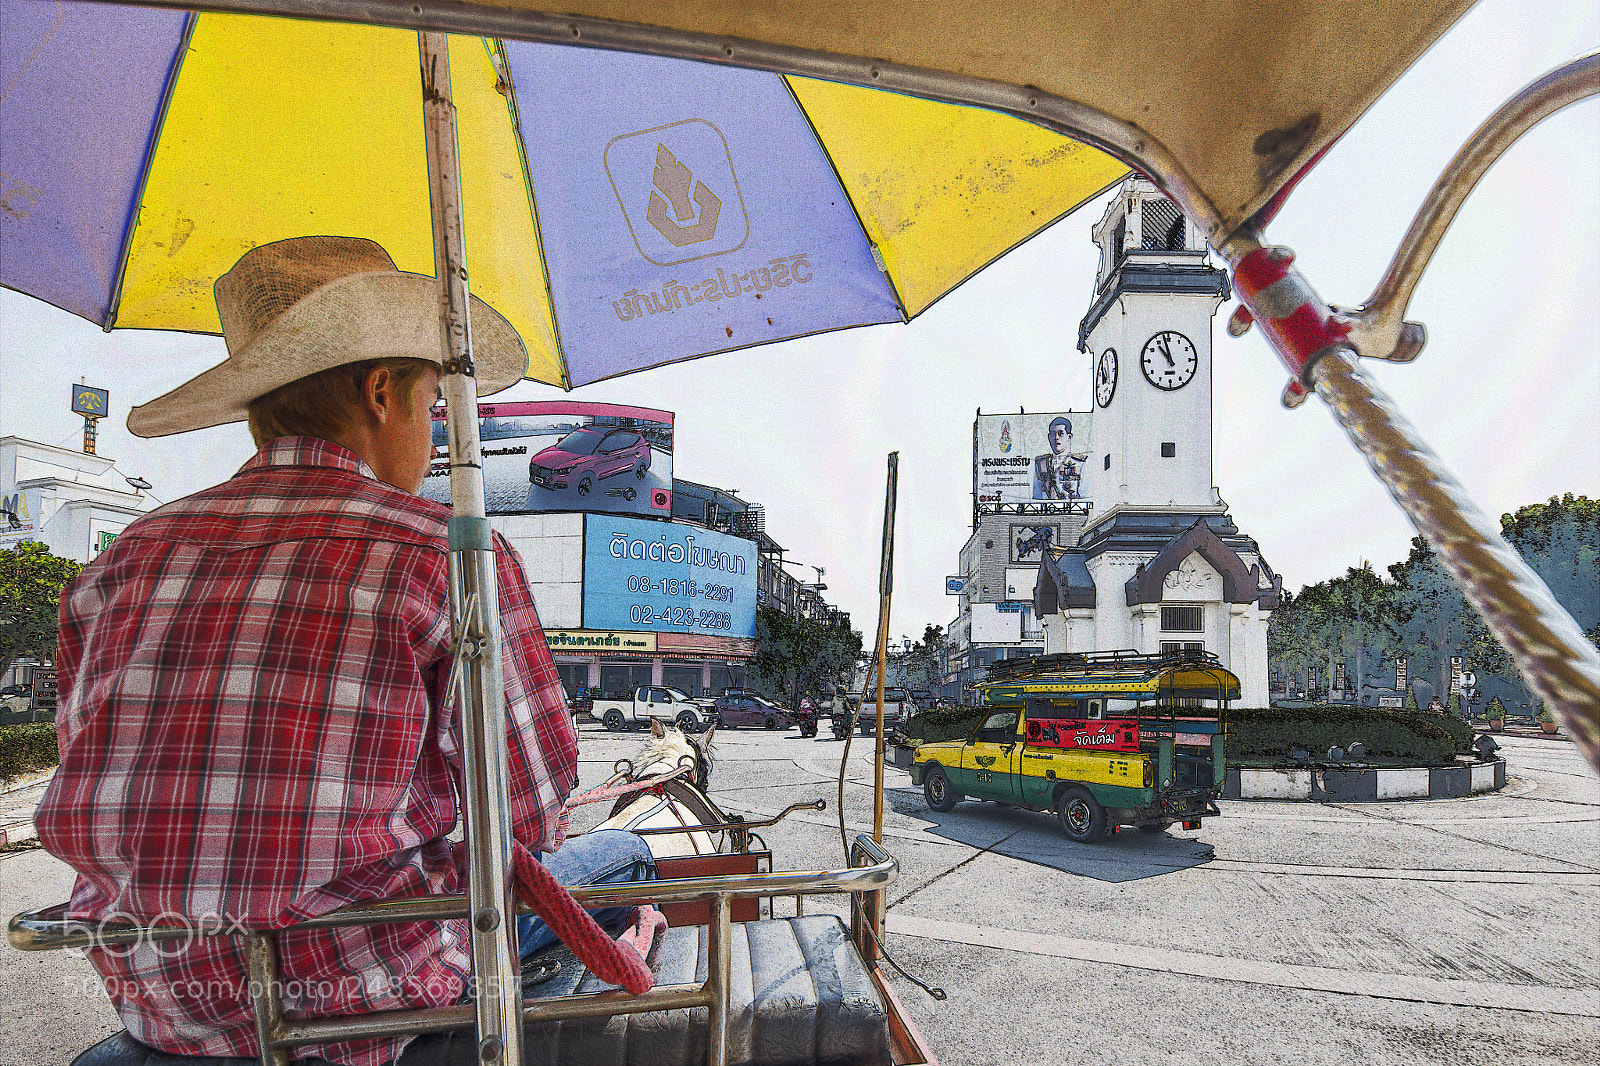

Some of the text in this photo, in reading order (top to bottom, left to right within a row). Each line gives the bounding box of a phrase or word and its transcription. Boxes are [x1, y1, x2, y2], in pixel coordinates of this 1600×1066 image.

[609, 531, 746, 576] ติดต่อโฆษณา
[627, 575, 734, 603] 08-1816-2291
[630, 604, 732, 630] 02-423-2288
[1073, 723, 1116, 746] จัดเต็ม
